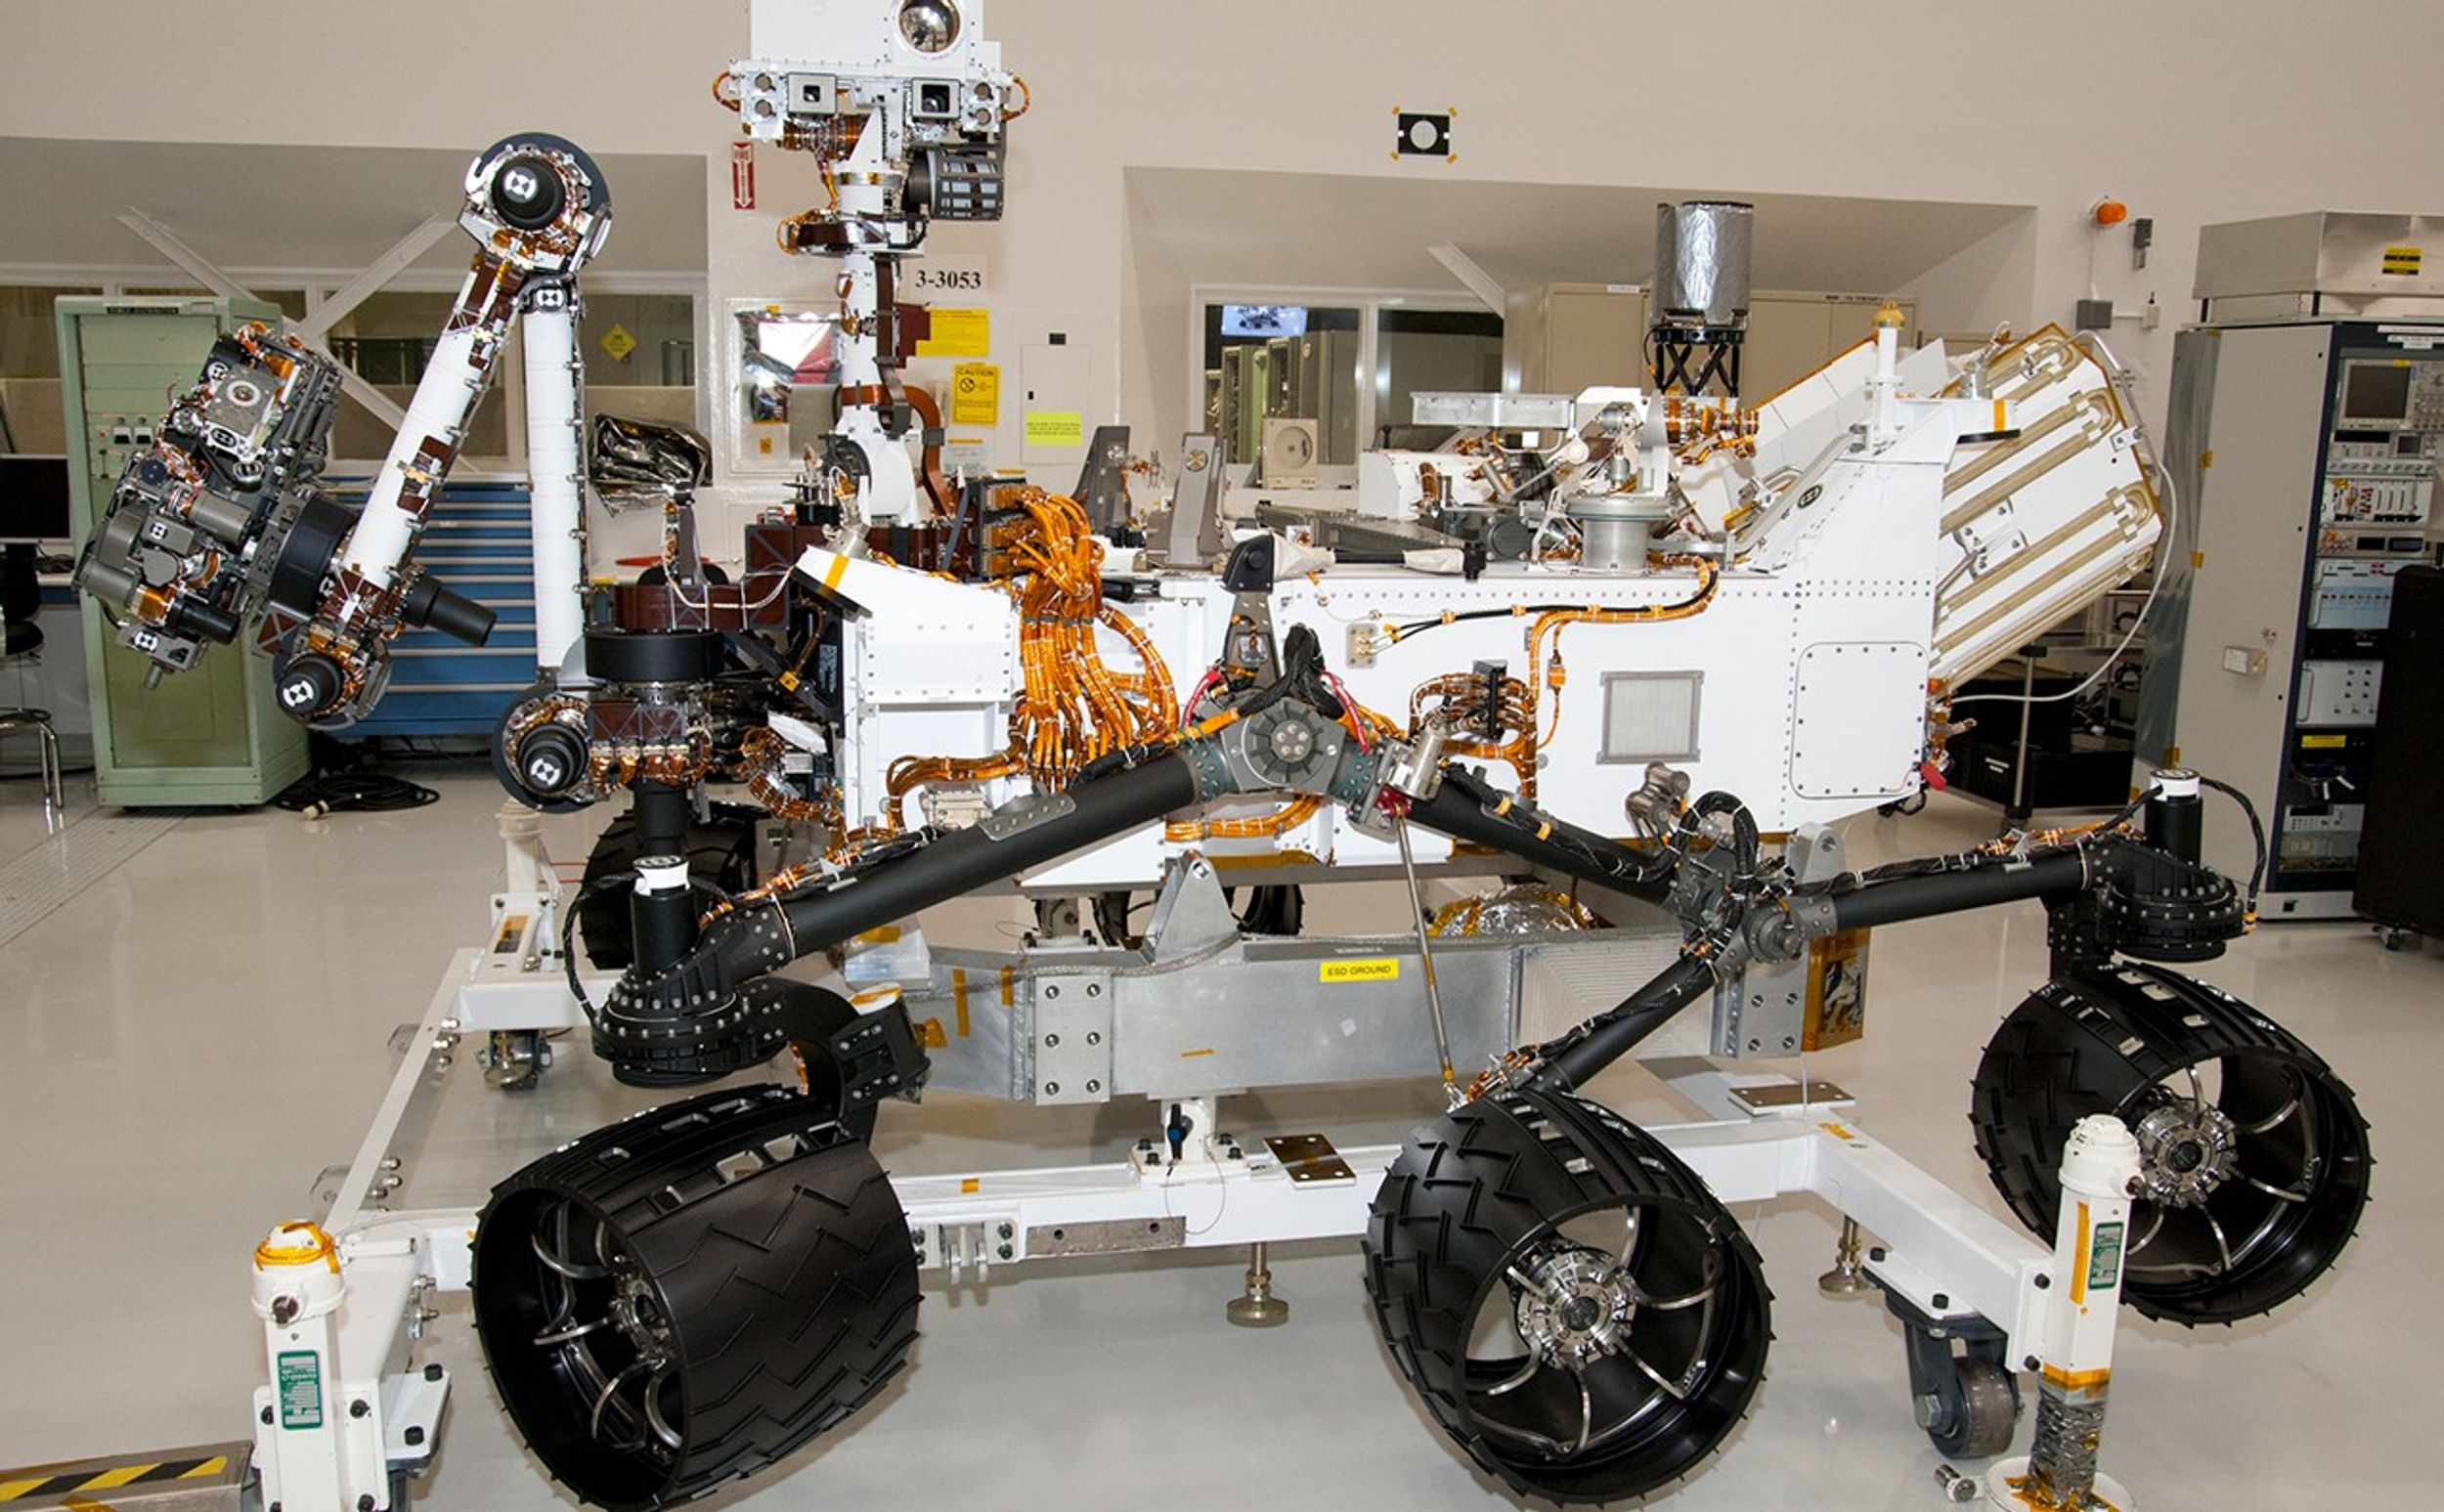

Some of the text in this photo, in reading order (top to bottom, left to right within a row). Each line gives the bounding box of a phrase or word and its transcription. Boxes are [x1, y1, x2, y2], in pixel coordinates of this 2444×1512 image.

[915, 270, 982, 289] 3-3053
[958, 367, 993, 377] CAUTION
[1328, 965, 1392, 976] ESD GROUND
